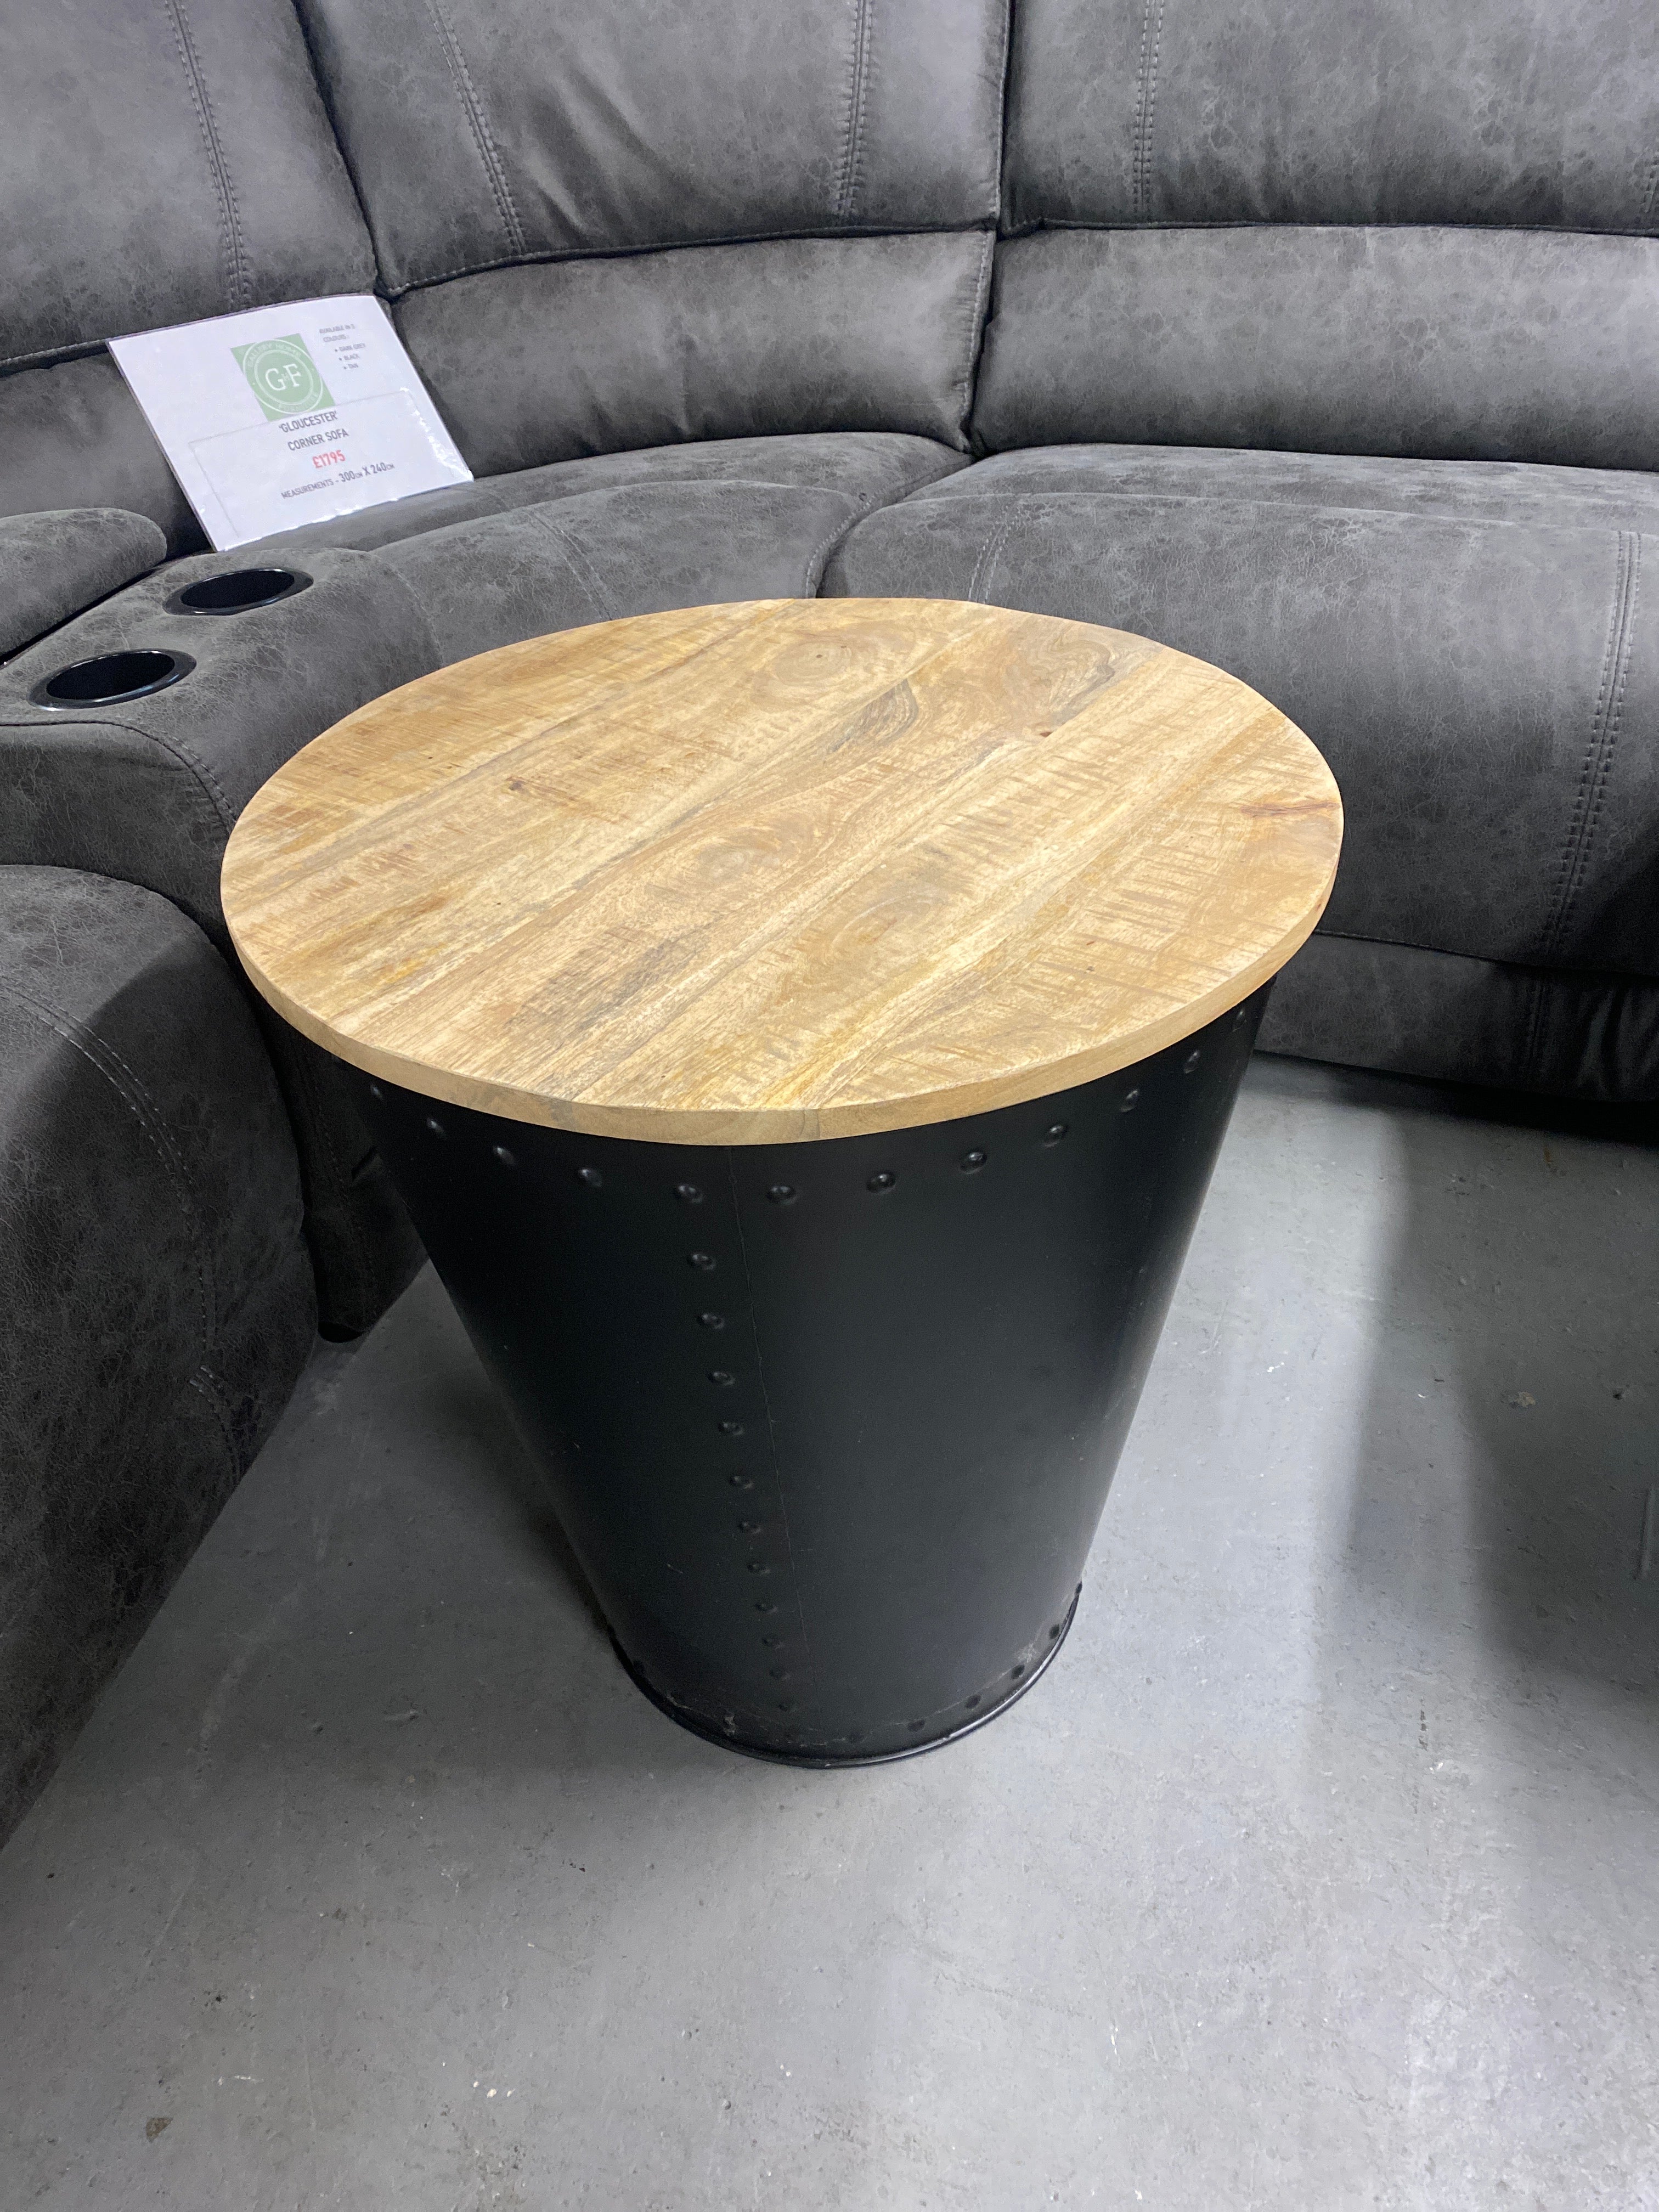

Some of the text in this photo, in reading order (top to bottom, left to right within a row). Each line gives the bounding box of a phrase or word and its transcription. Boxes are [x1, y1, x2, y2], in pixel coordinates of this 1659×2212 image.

[319, 325, 345, 334] AVAILABLE
[247, 343, 302, 367] GALLERY HOME
[287, 428, 349, 451] CORNER SOFA
[312, 449, 346, 469] £1795
[281, 478, 334, 499] MEASUREMENTS
[362, 467, 370, 476] X
